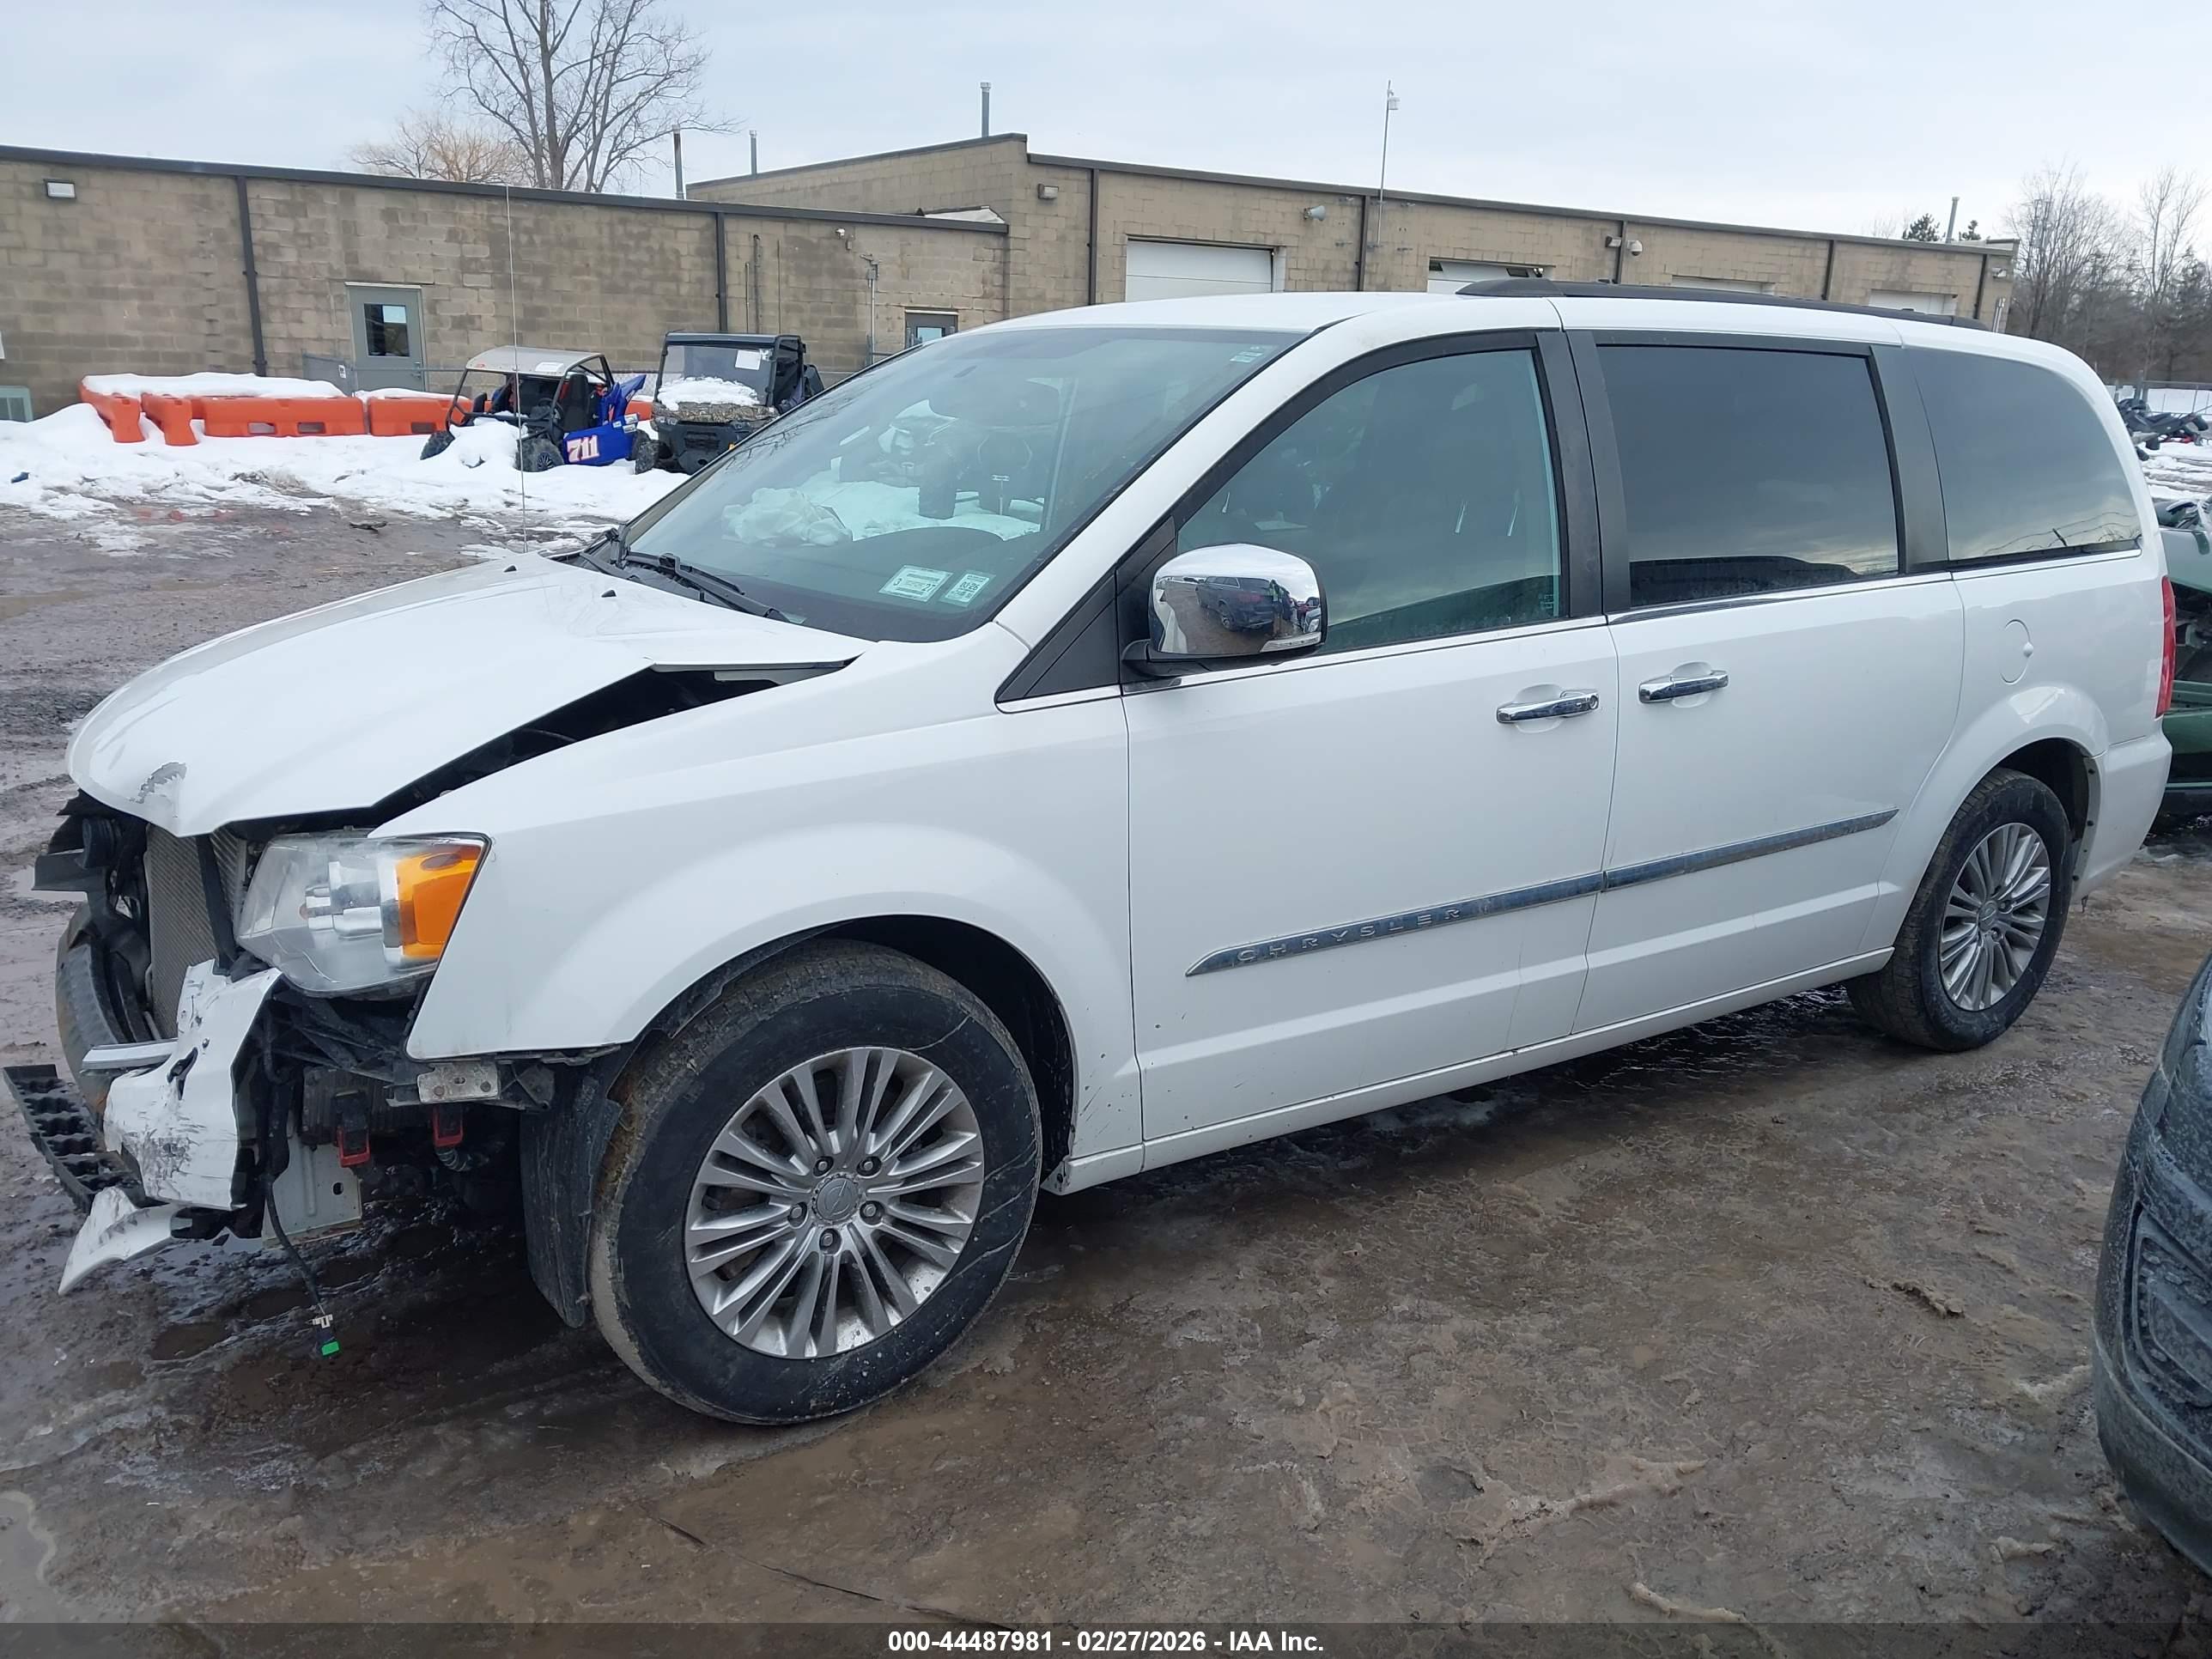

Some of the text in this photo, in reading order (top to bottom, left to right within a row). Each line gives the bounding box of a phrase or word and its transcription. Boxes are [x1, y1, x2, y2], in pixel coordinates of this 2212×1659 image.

[567, 434, 599, 463] 711
[892, 577, 902, 586] 3
[921, 583, 936, 592] 27
[1237, 908, 1461, 962] CHRYSLER
